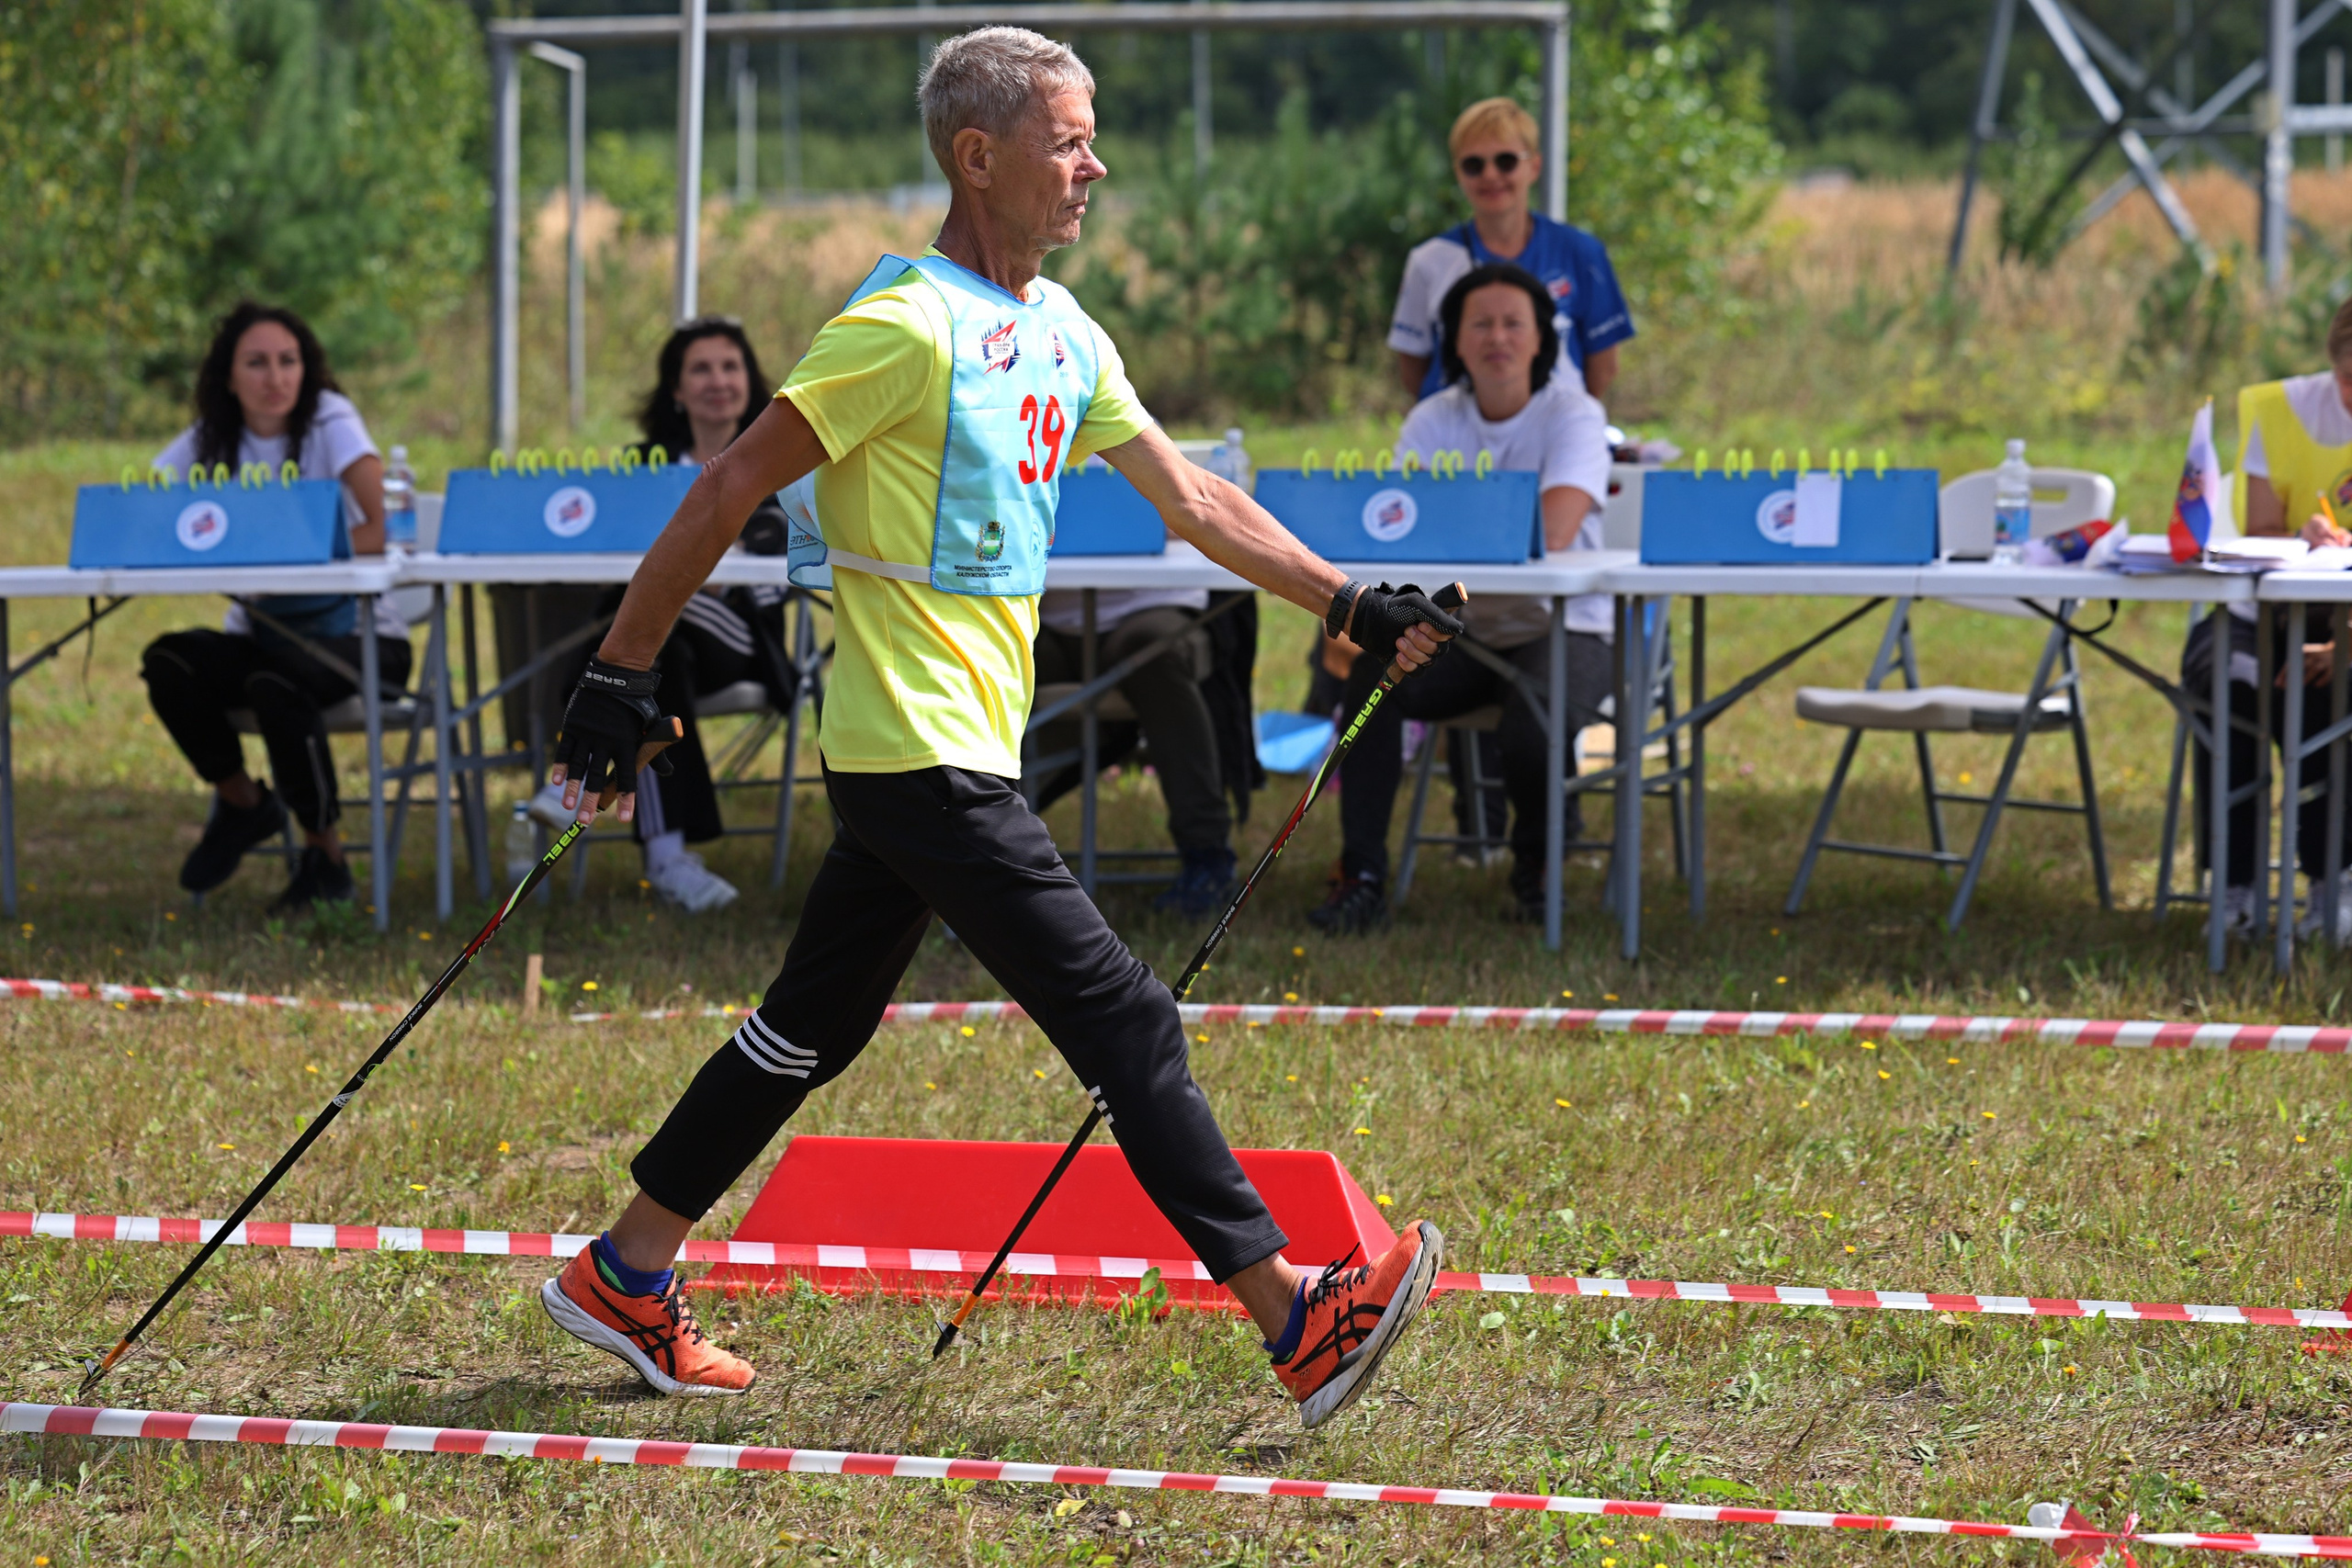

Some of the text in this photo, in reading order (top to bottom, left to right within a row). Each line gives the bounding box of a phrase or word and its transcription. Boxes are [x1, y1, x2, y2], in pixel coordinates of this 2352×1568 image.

[1018, 394, 1066, 485] 39
[954, 564, 995, 572] МИНИСТЕРСТВО
[585, 671, 627, 687] GABE
[1339, 688, 1384, 746] GABEL
[1221, 905, 1236, 926] SNAKE
[1204, 923, 1223, 950] CARBON
[407, 1002, 423, 1021] SNAKE
[389, 1019, 409, 1043] CARBON
